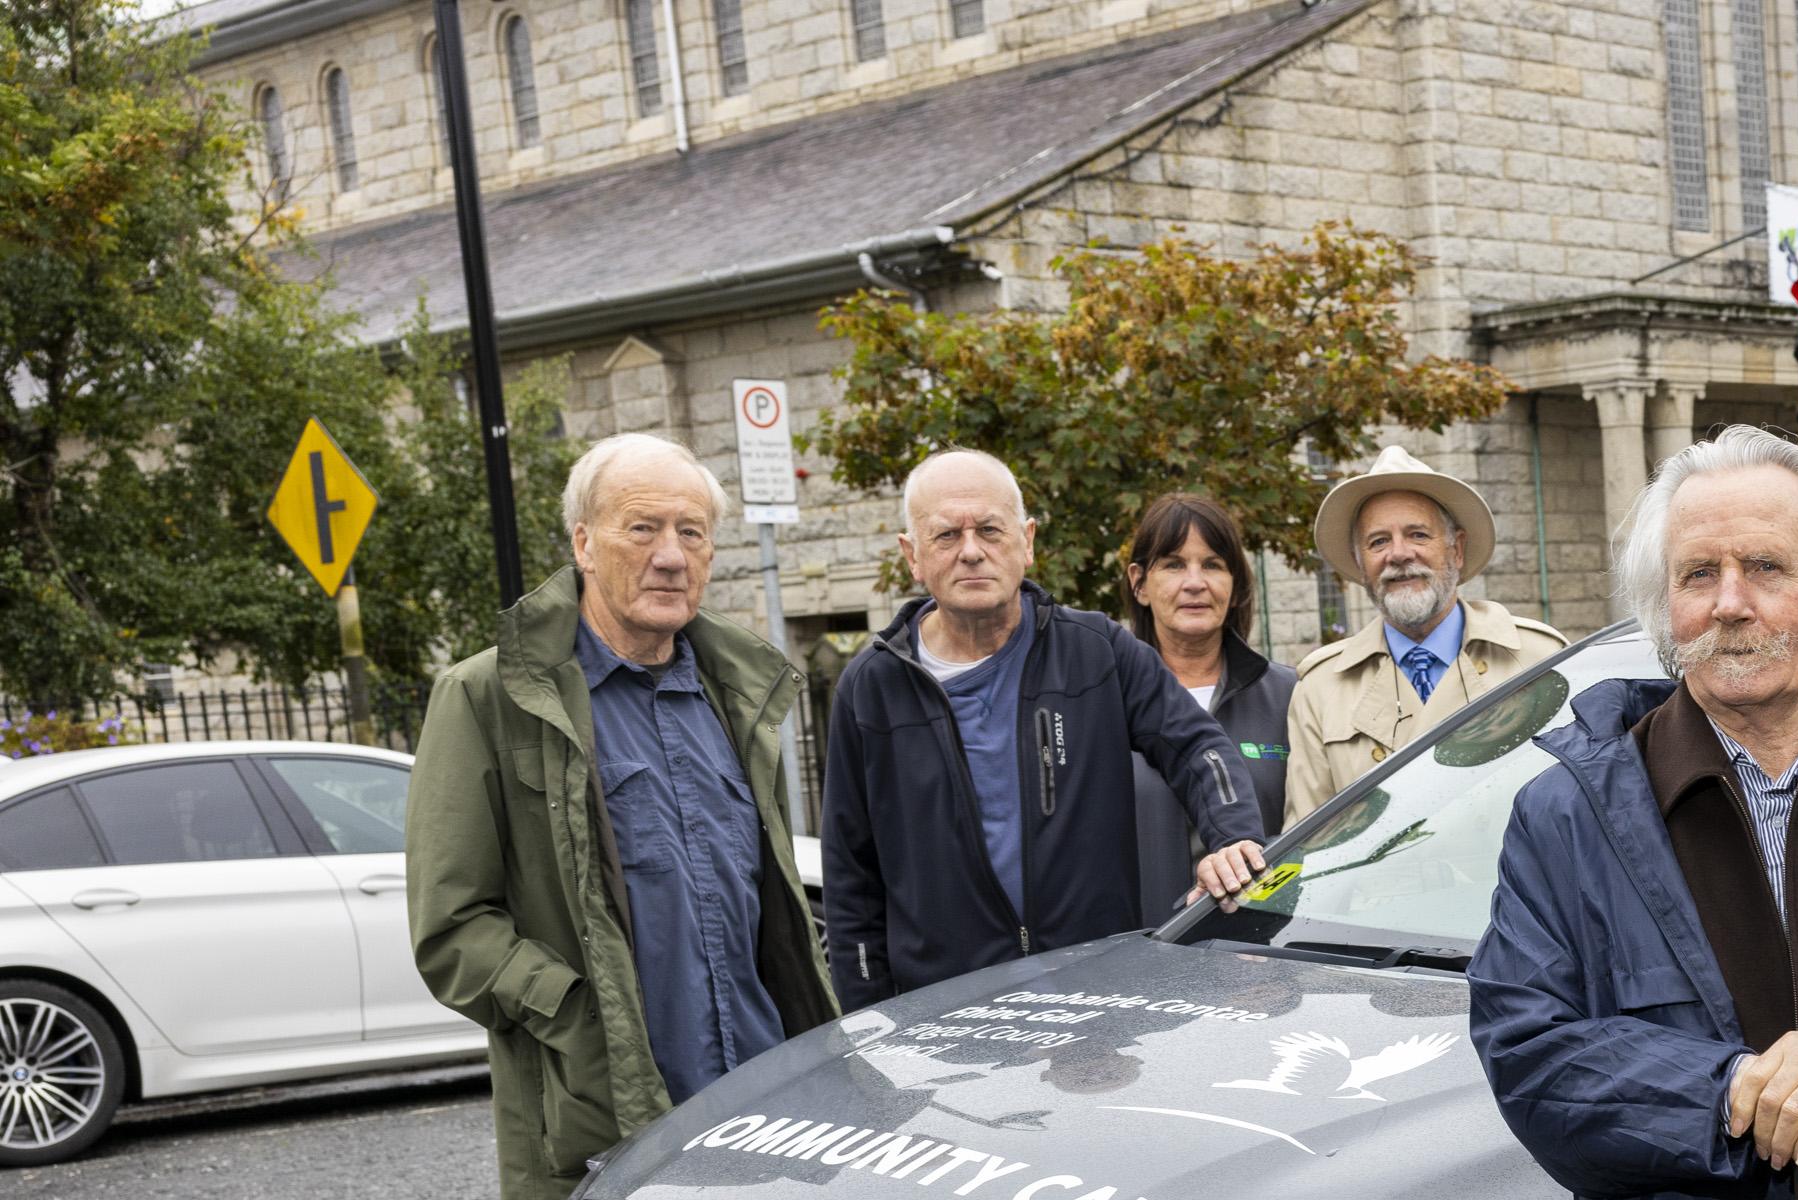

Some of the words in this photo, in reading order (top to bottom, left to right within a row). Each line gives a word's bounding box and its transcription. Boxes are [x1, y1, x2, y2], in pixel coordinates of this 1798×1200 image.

[754, 394, 769, 419] P
[940, 1006, 1031, 1020] Fhine
[1025, 1009, 1105, 1024] Gall
[993, 992, 1149, 1008] Comhairle
[1145, 999, 1270, 1022] Contae
[973, 1026, 1088, 1049] County
